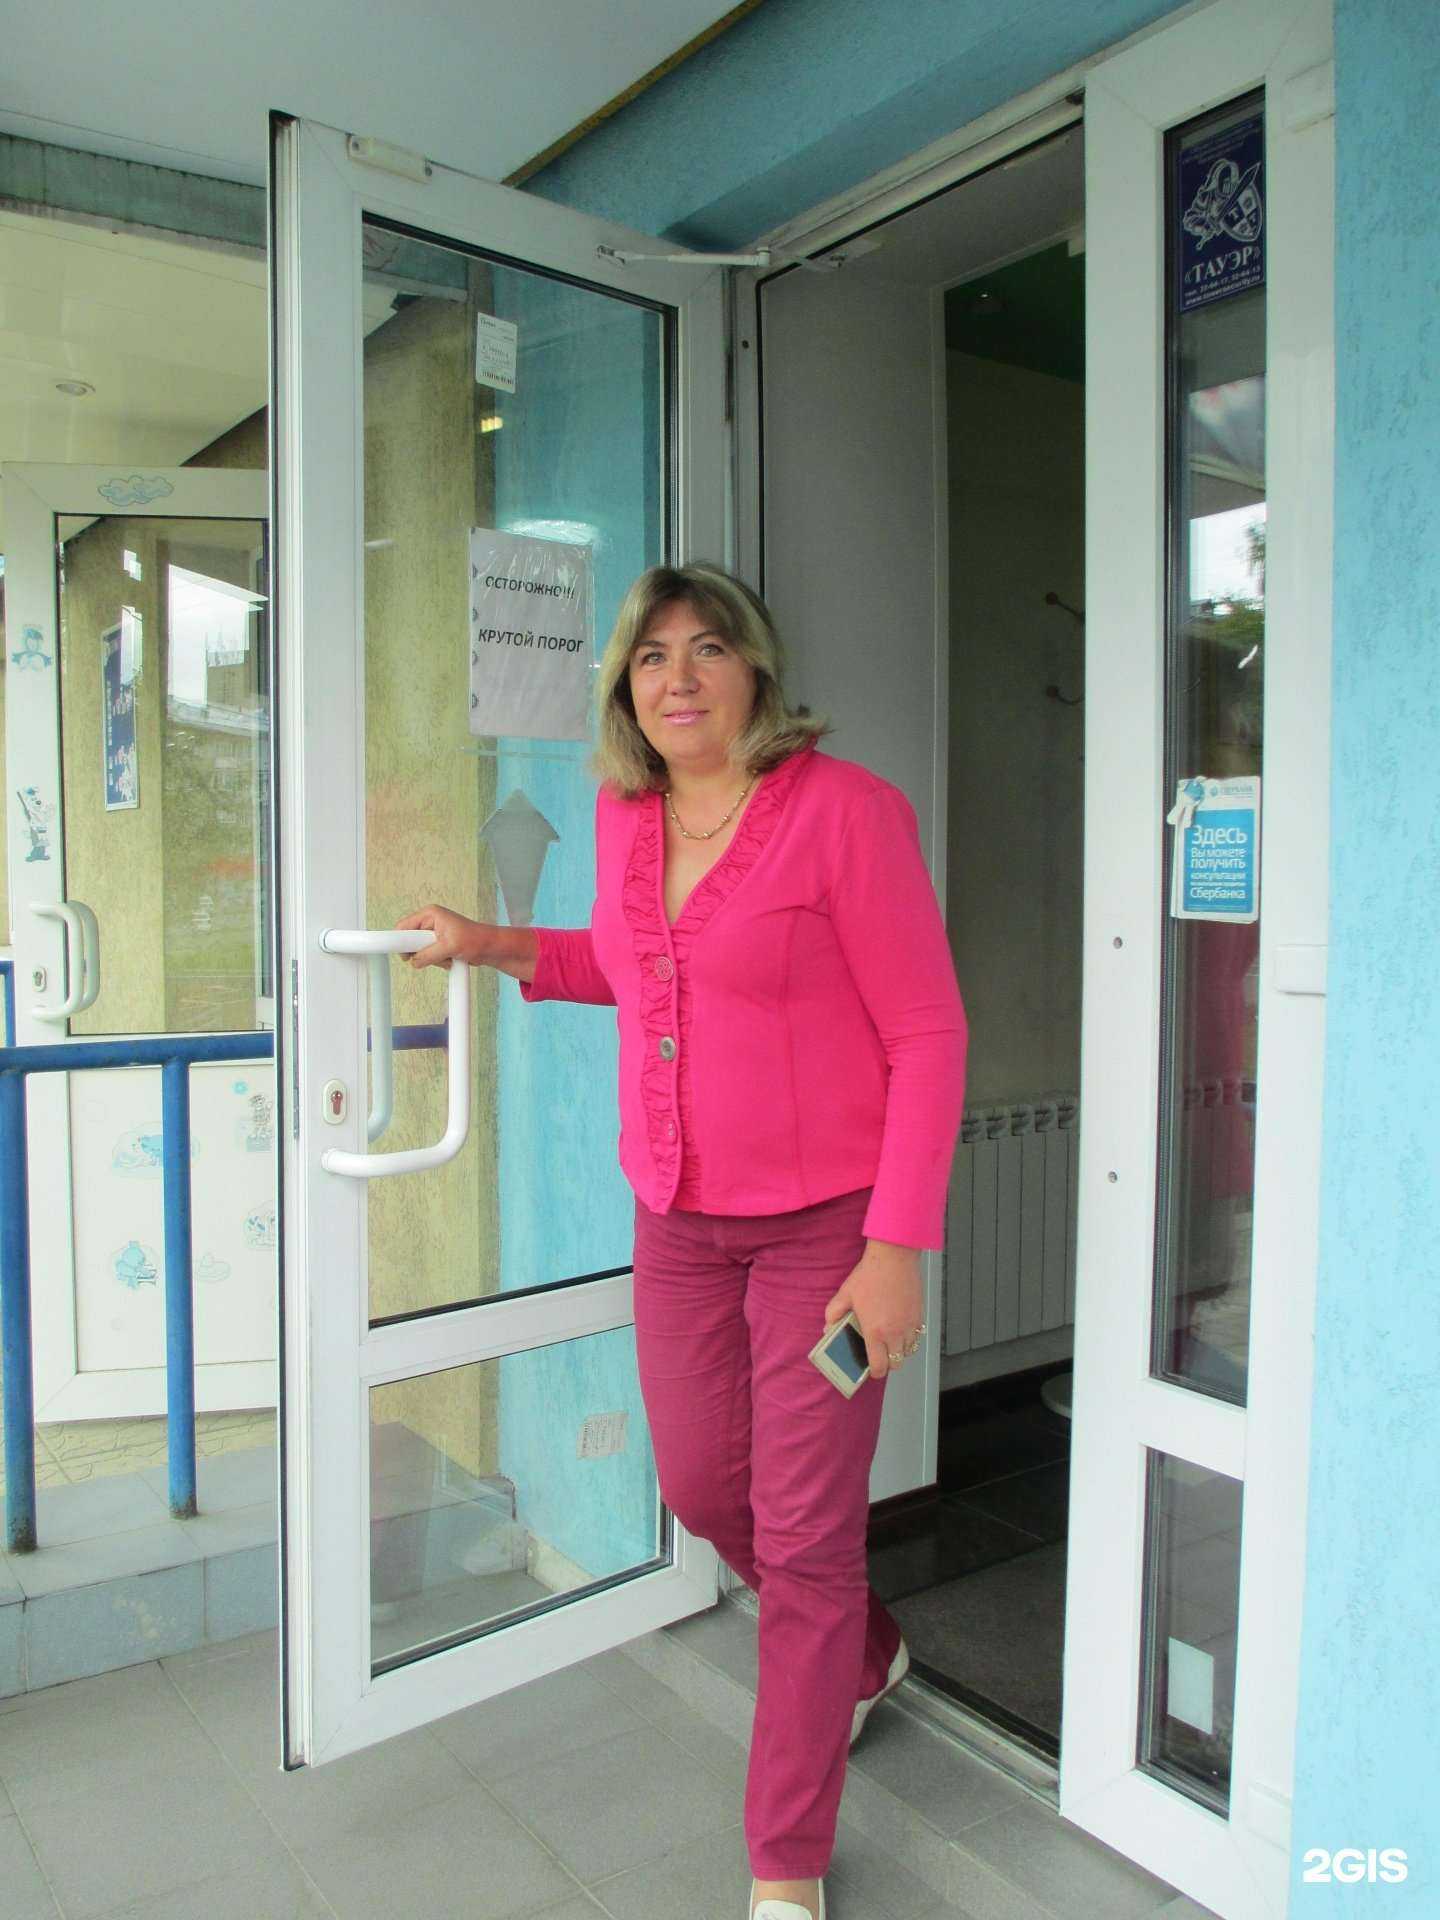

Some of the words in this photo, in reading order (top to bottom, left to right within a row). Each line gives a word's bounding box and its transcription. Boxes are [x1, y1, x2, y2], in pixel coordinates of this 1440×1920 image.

[485, 575, 575, 600] ОСТОРОЖНО!!!
[478, 628, 534, 648] КРУТОЙ
[537, 635, 584, 653] ПОРОГ
[1191, 825, 1247, 848] Здесь
[1190, 858, 1246, 873] получить
